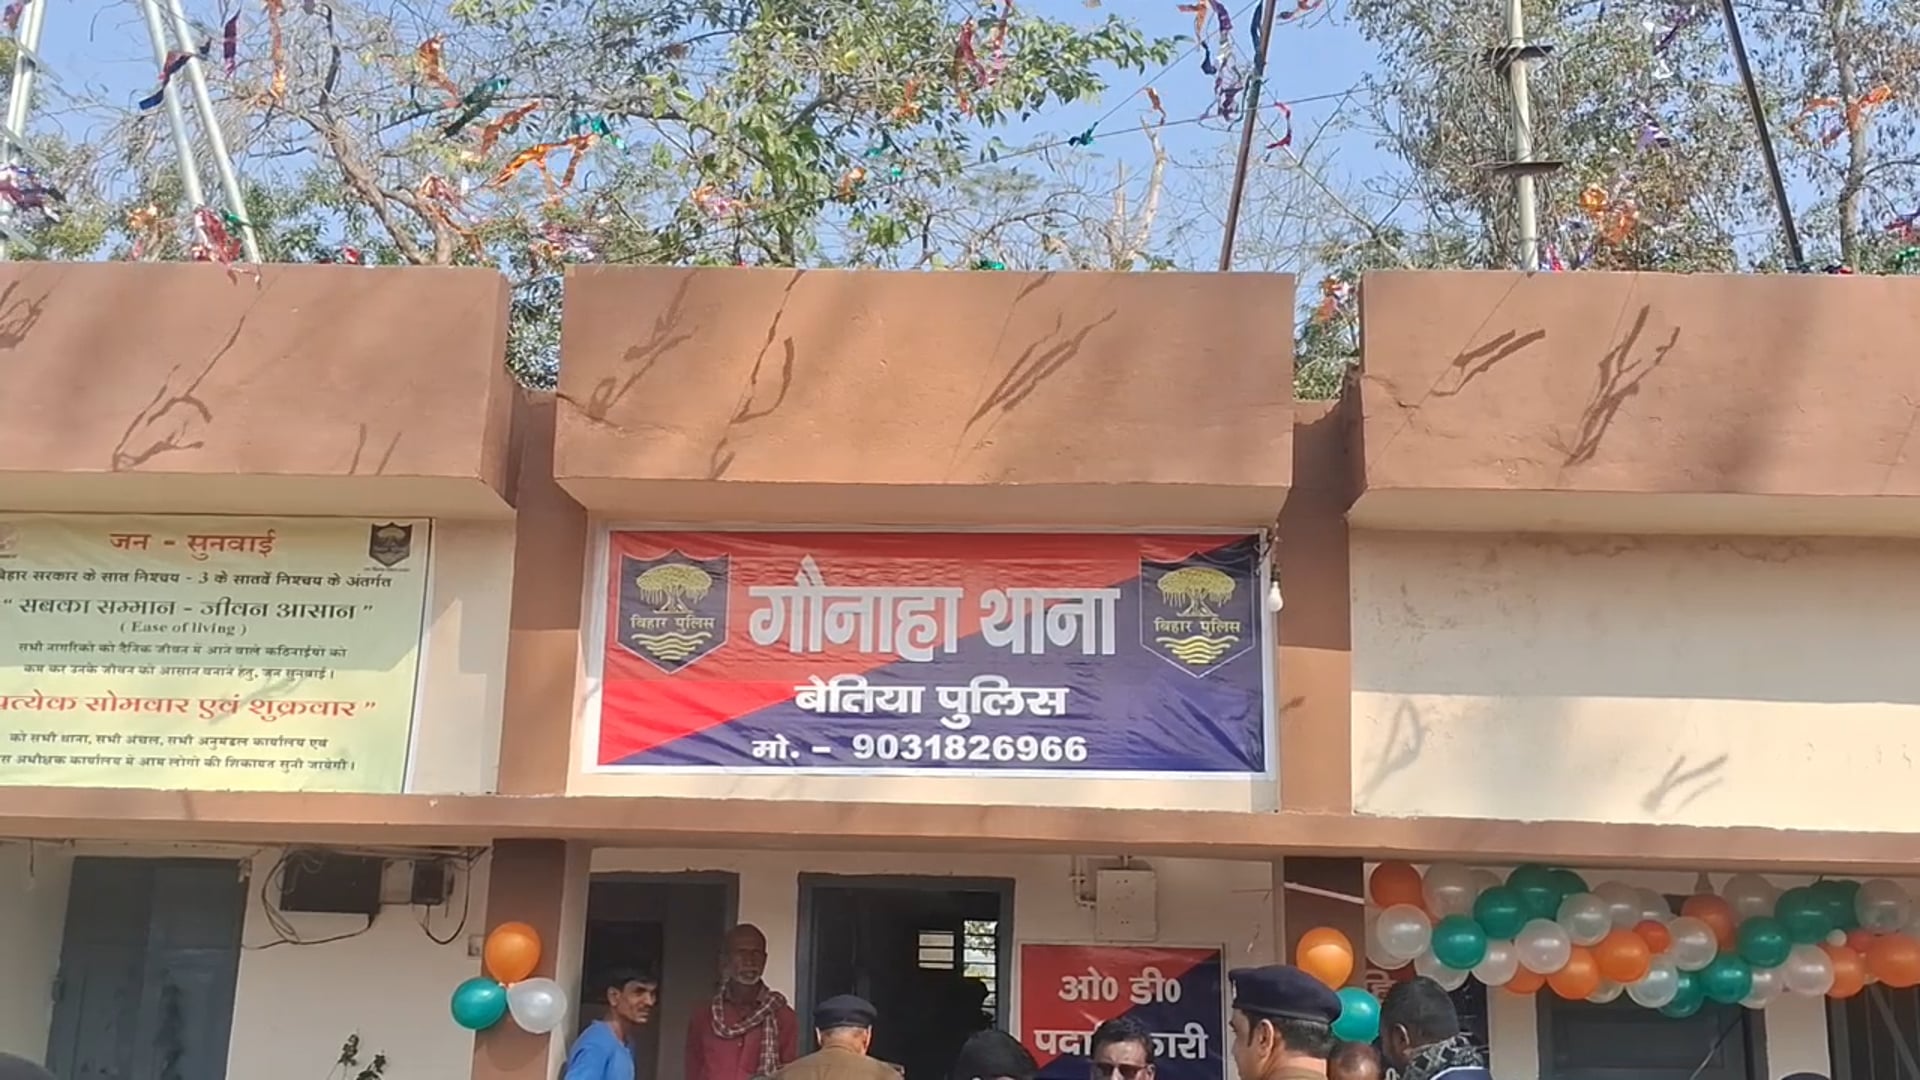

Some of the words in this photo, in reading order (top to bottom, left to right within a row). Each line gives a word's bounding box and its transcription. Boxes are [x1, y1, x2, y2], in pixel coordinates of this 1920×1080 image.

[109, 532, 152, 551] जन
[187, 528, 276, 561] सुनवाई
[32, 570, 79, 583] सरकार
[82, 568, 96, 582] के
[101, 570, 129, 583] सात
[134, 568, 180, 584] निश्चय
[198, 571, 209, 585] 3
[214, 571, 228, 585] के
[233, 571, 271, 585] सातवें
[276, 571, 321, 587] निश्चय
[327, 572, 341, 587] के
[346, 573, 393, 588] अंतर्गत
[19, 599, 91, 614] सबका
[97, 600, 176, 616] सम्मान
[200, 596, 268, 617] जीवन
[276, 603, 356, 619] आसान
[749, 553, 963, 662] गौनाहा
[980, 587, 1121, 656] थाना
[131, 621, 168, 633] Ease
[171, 621, 190, 633] of
[192, 621, 236, 636] living
[630, 614, 667, 629] बिहार
[676, 614, 715, 633] पुलिस
[1153, 617, 1193, 634] बिहार
[1199, 617, 1241, 637] पुलिस
[18, 641, 43, 652] सभी
[119, 641, 152, 653] दैनिक
[155, 642, 189, 655] जीवन
[160, 665, 200, 676] आसान
[262, 668, 282, 679] जन
[85, 690, 191, 714] सोमवार
[198, 694, 241, 719] एवं
[248, 698, 356, 722] शुक्रवार
[794, 674, 925, 714] बेतिया
[936, 675, 1070, 730] पुलिस
[31, 730, 57, 743] सभी
[96, 732, 122, 745] सभी
[168, 733, 193, 745] सभी
[852, 733, 1088, 762] 9031826966
[138, 756, 166, 767] आम
[225, 755, 275, 769] शिकायत
